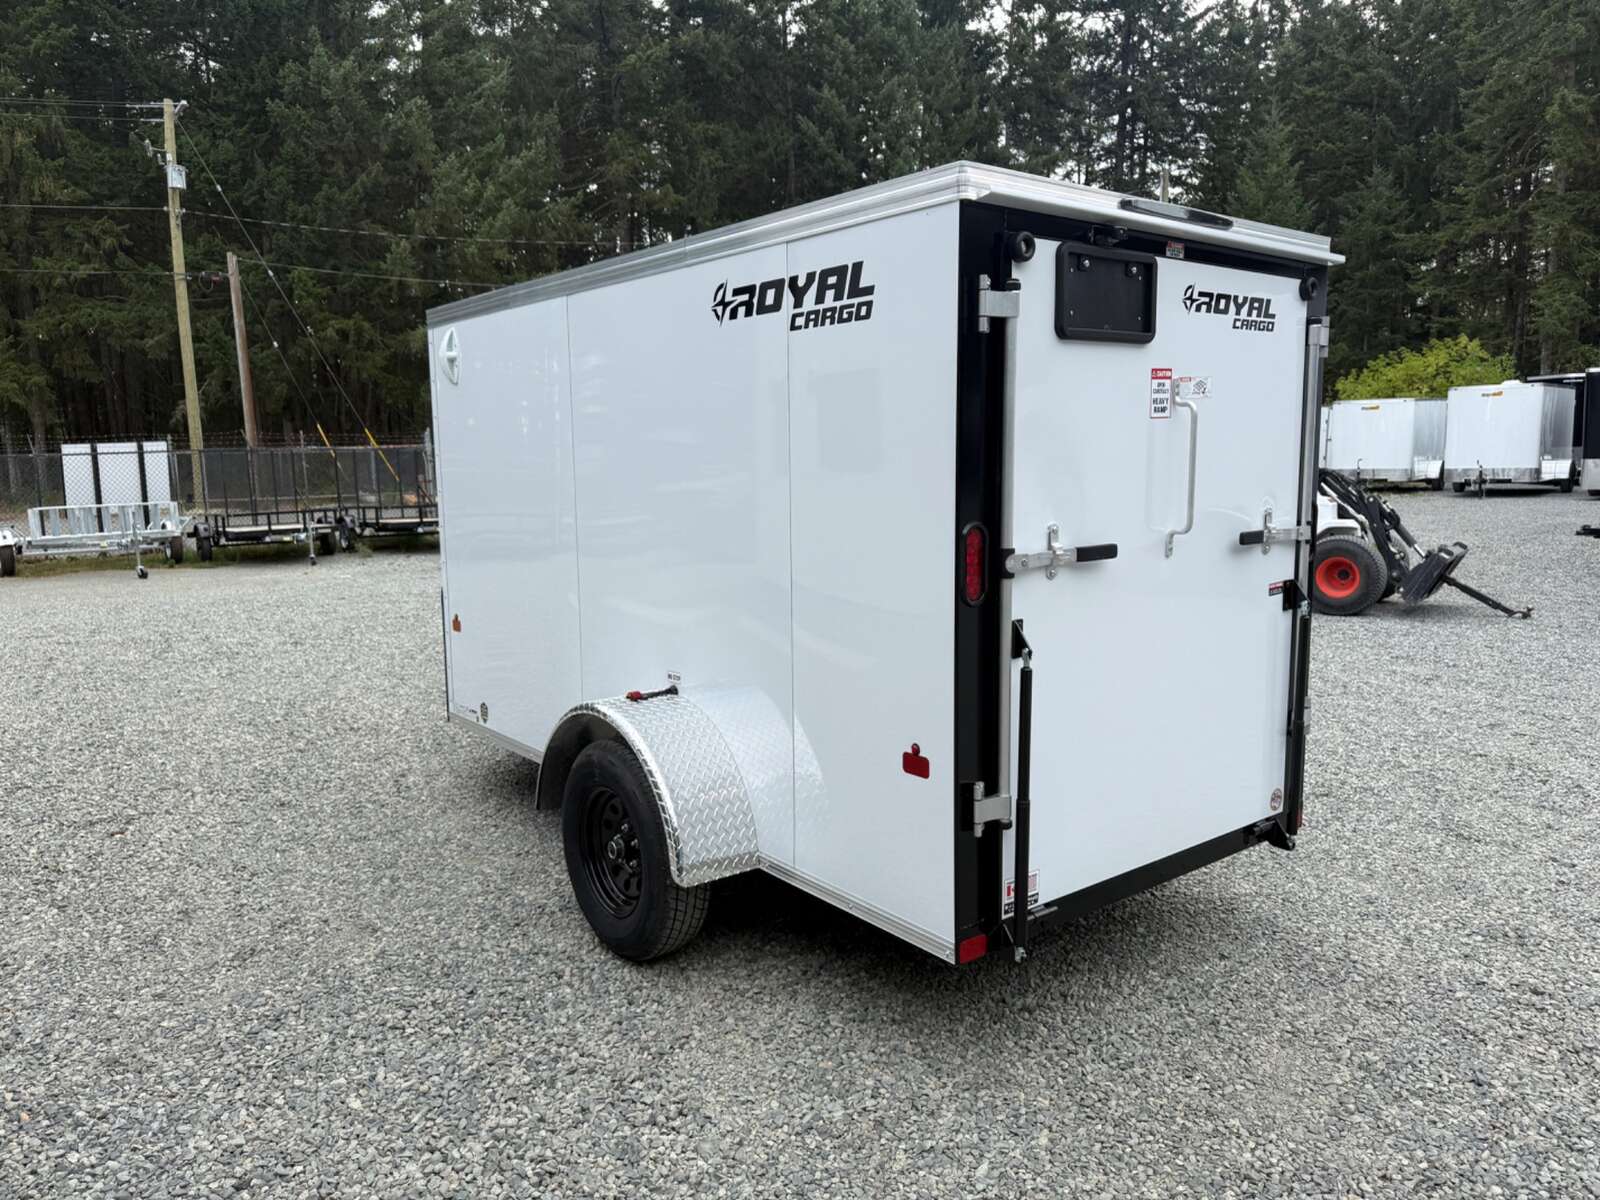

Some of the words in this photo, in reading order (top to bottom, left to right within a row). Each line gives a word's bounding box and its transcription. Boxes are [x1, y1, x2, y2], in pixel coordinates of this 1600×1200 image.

[729, 260, 875, 320] ROYAL
[1195, 291, 1276, 319] ROYAL
[789, 299, 874, 332] CARGO
[1232, 318, 1275, 332] CARGO
